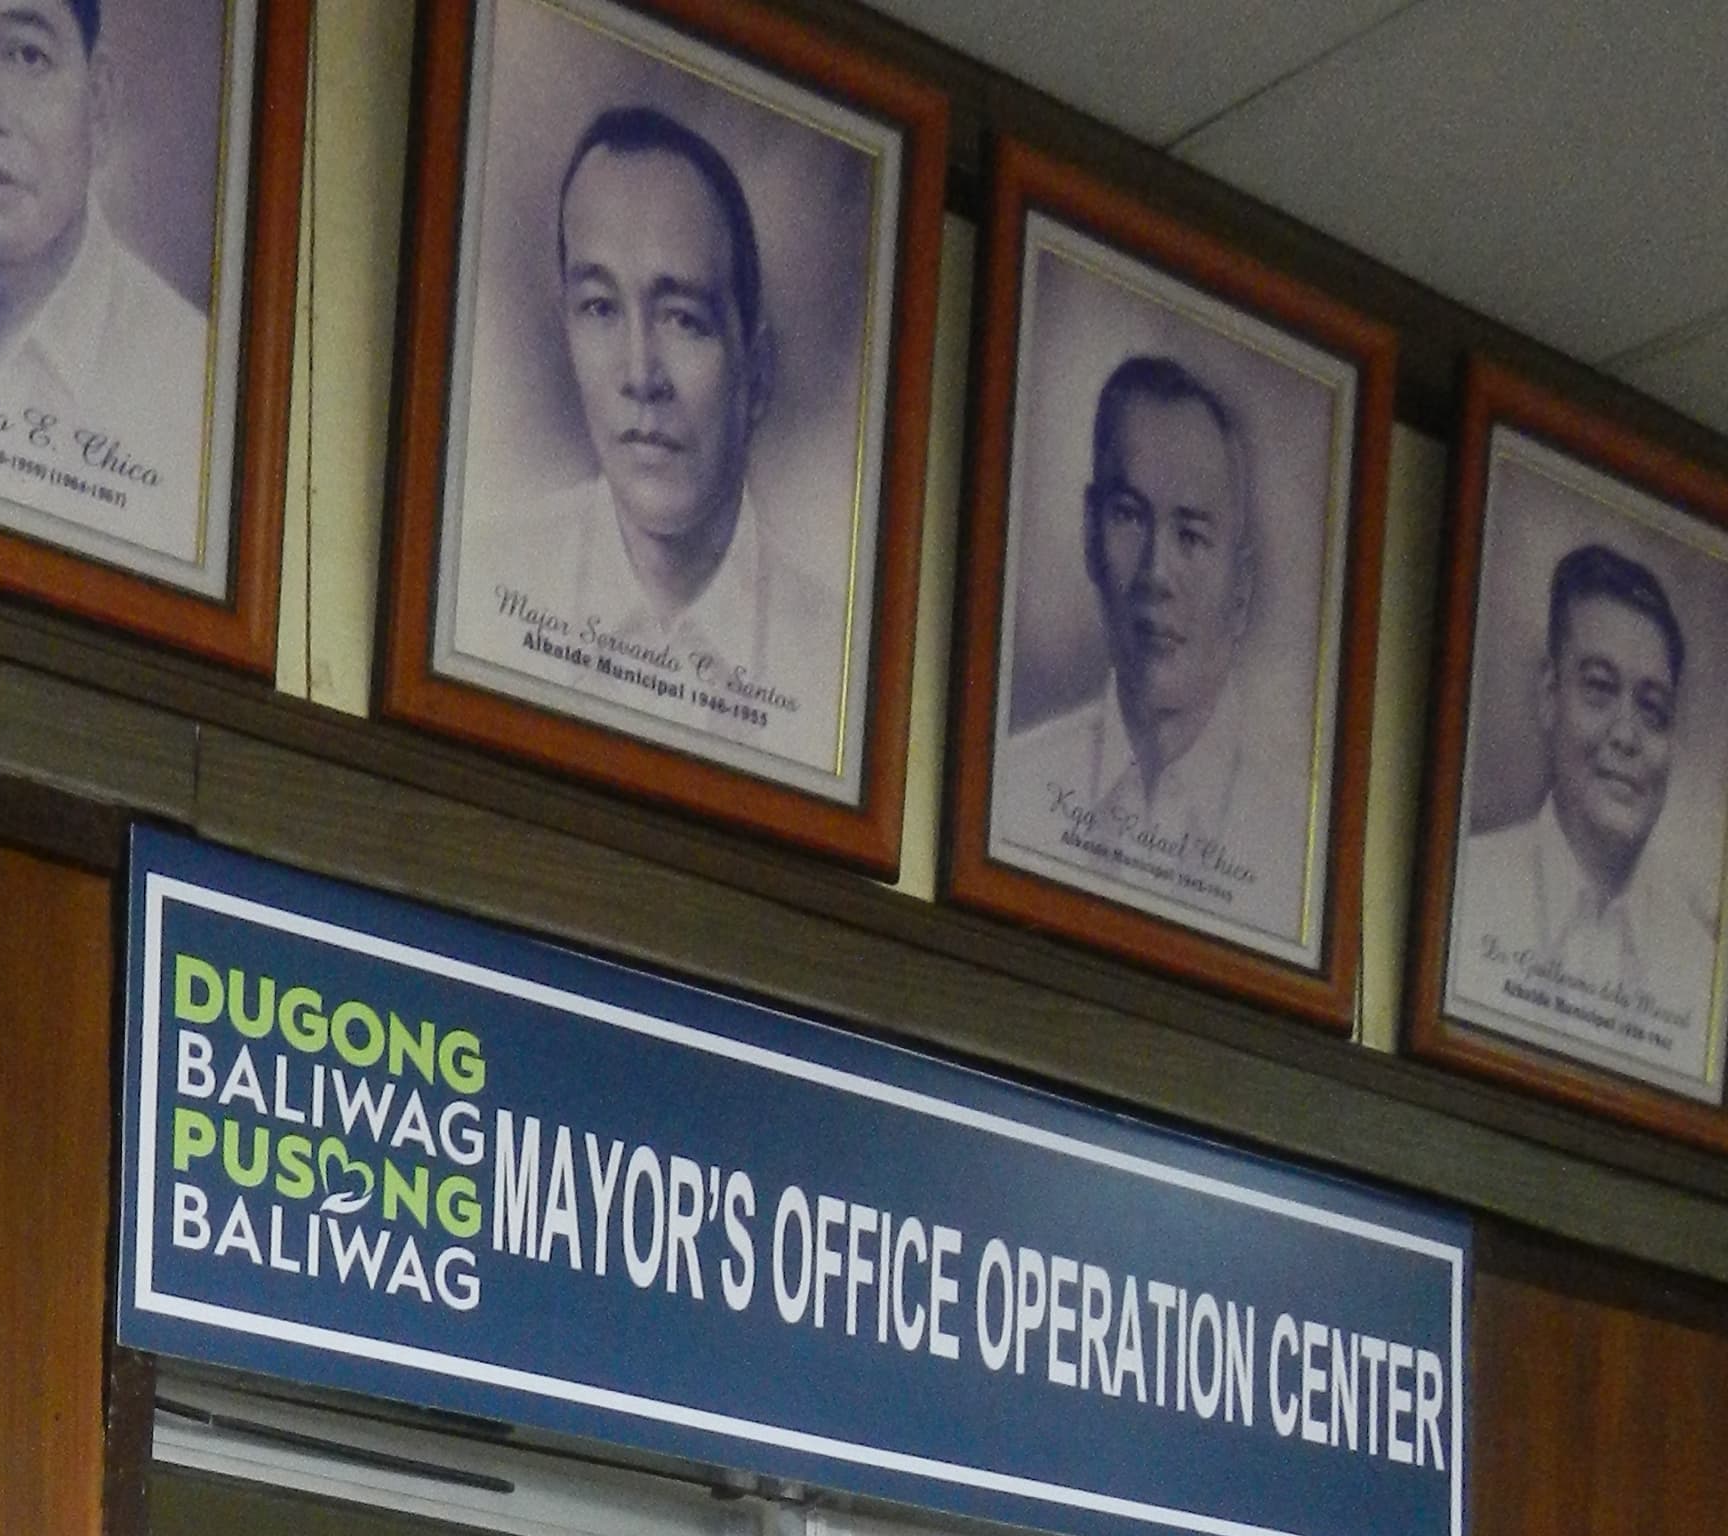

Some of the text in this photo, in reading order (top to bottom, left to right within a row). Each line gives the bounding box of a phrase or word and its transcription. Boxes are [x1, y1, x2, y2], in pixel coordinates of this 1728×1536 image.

[23, 408, 58, 452] E.
[74, 428, 162, 488] Chico
[494, 584, 801, 714] Major Servando C. Santos
[596, 656, 685, 700] Municipal
[174, 952, 486, 1095] DUGONG
[177, 1029, 486, 1167] BALIWAG
[172, 1183, 482, 1311] BALIWAG
[492, 1108, 1445, 1471] MAYOR'S OFFICE OPERATION CENTER
